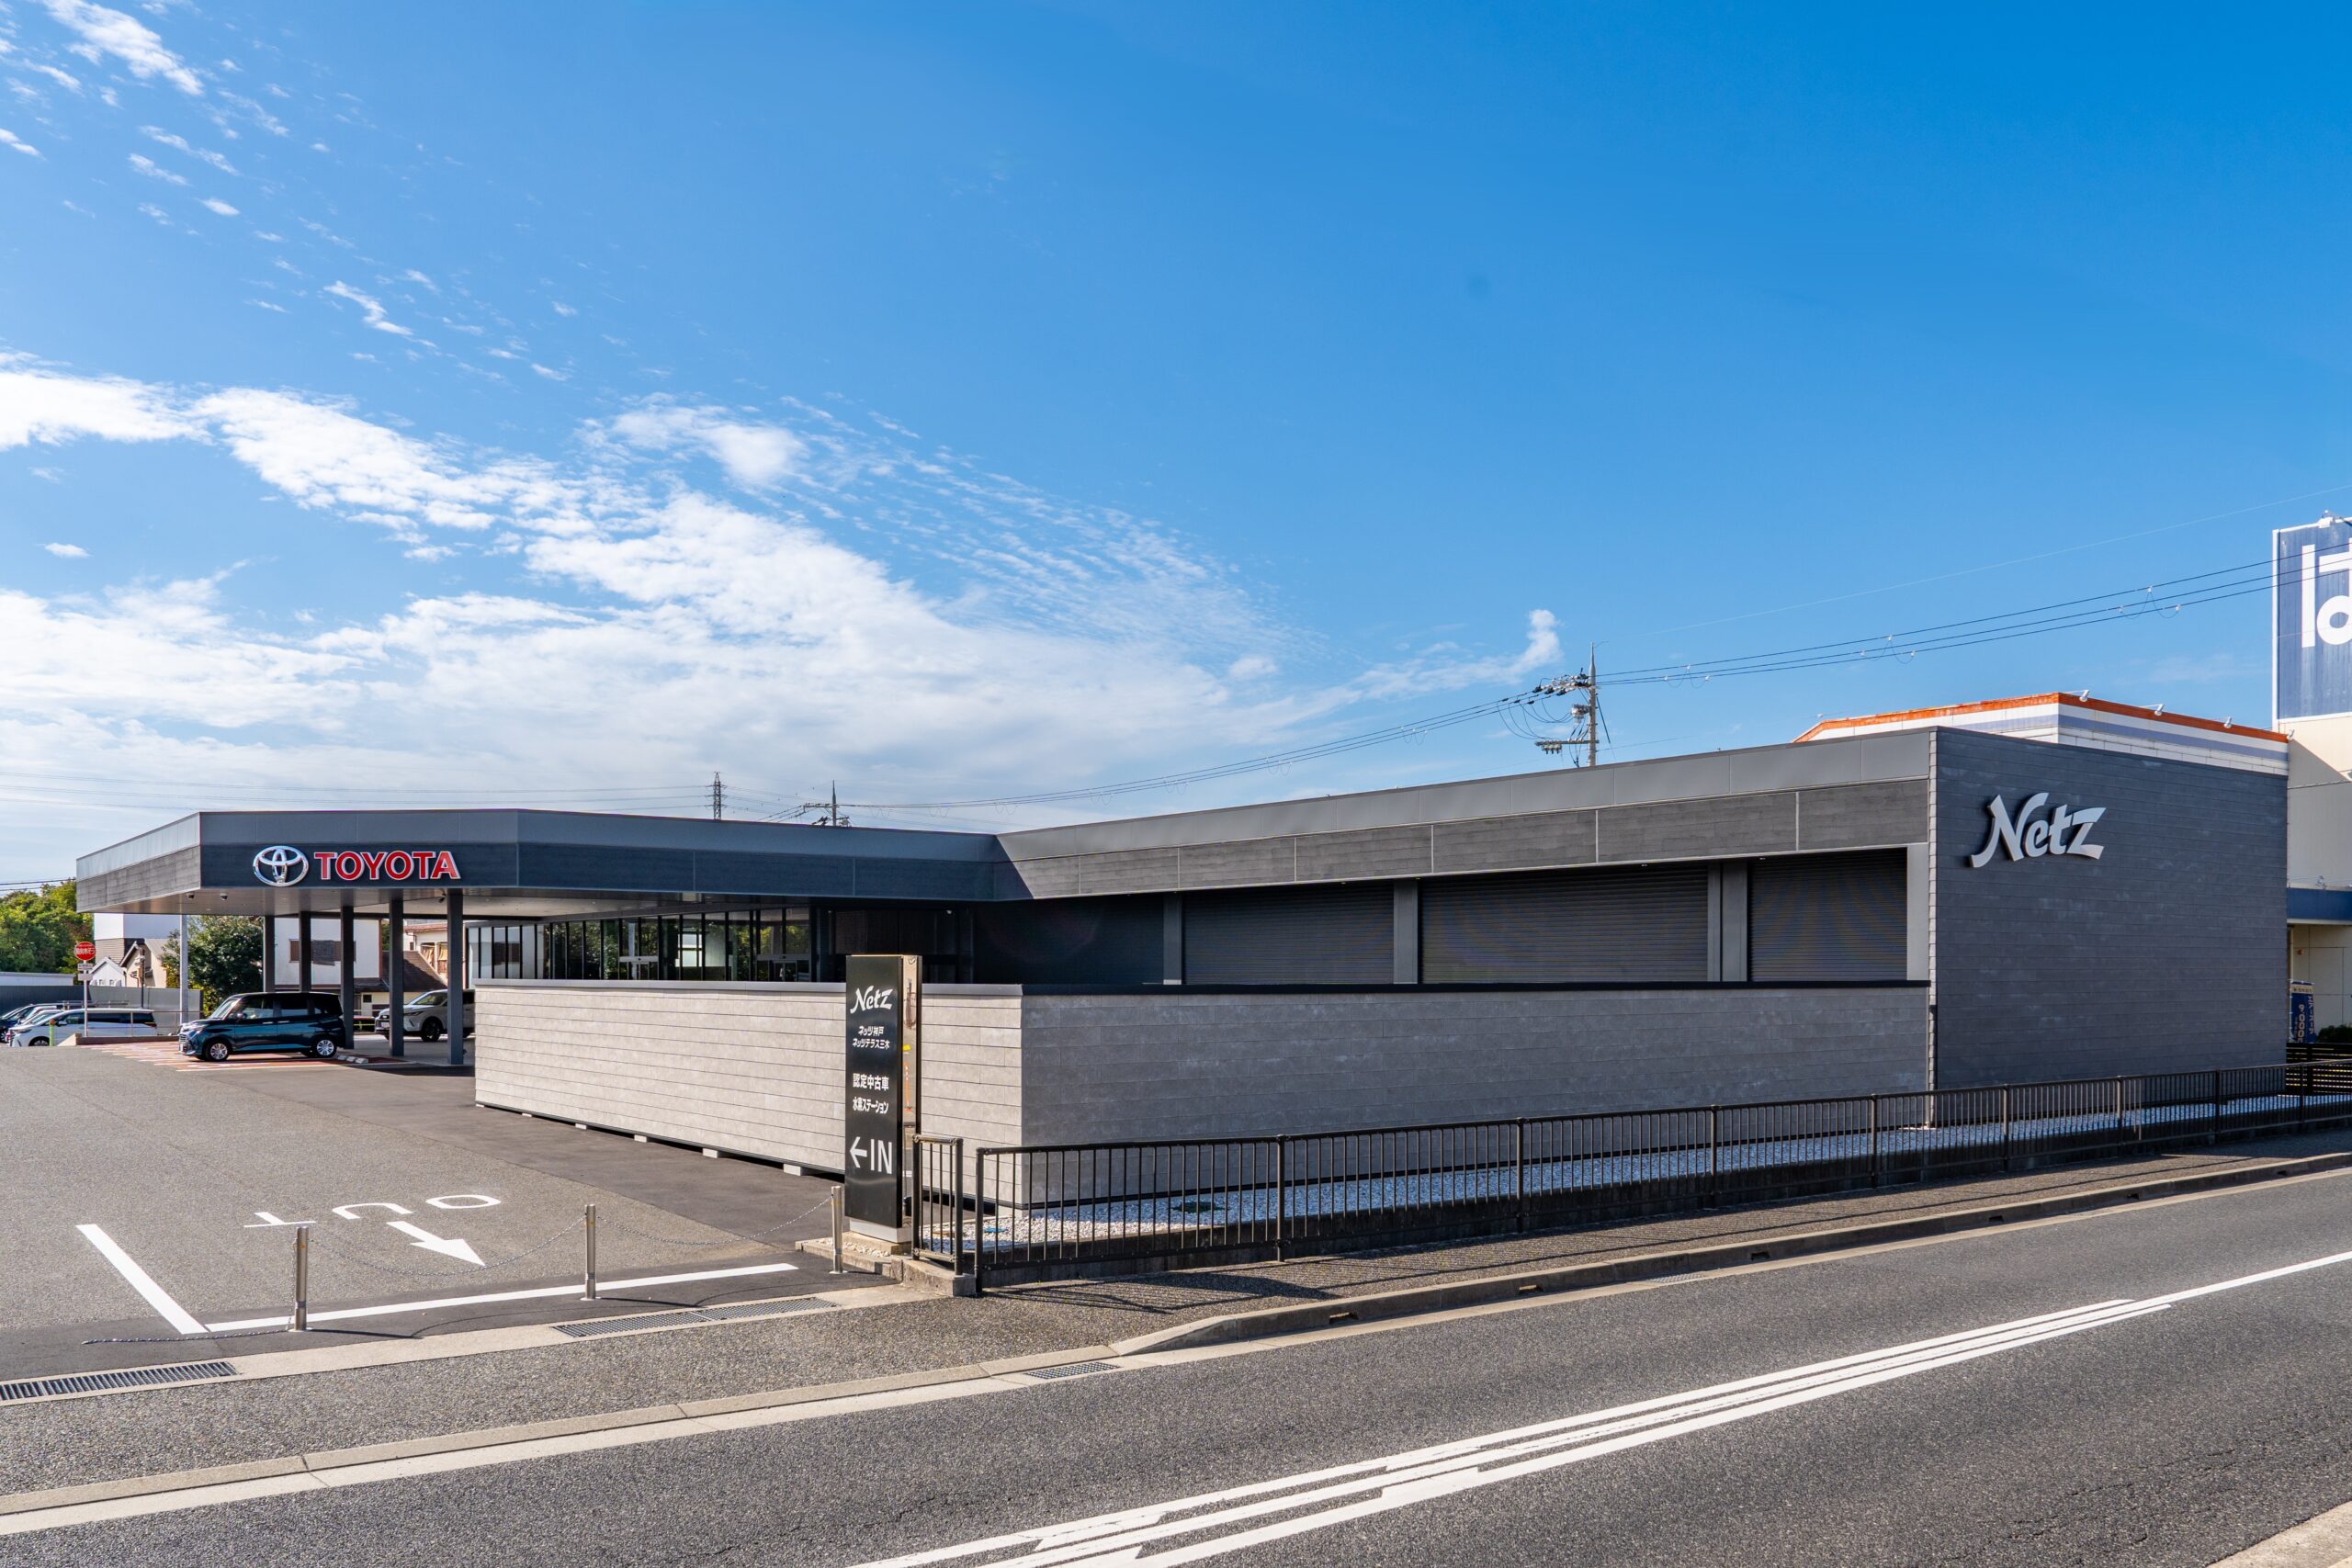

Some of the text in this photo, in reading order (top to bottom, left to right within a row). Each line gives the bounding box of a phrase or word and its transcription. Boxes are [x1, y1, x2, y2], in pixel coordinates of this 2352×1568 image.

[1970, 793, 2107, 868] Netz
[314, 851, 461, 881] TOYOTA
[850, 986, 893, 1014] Netz
[853, 1038, 890, 1050] ネッツテラス三木
[858, 1025, 885, 1037] ネッツ神戸
[853, 1073, 889, 1091] 認定中古車
[870, 1139, 892, 1175] IN
[243, 1195, 502, 1228] OUT
